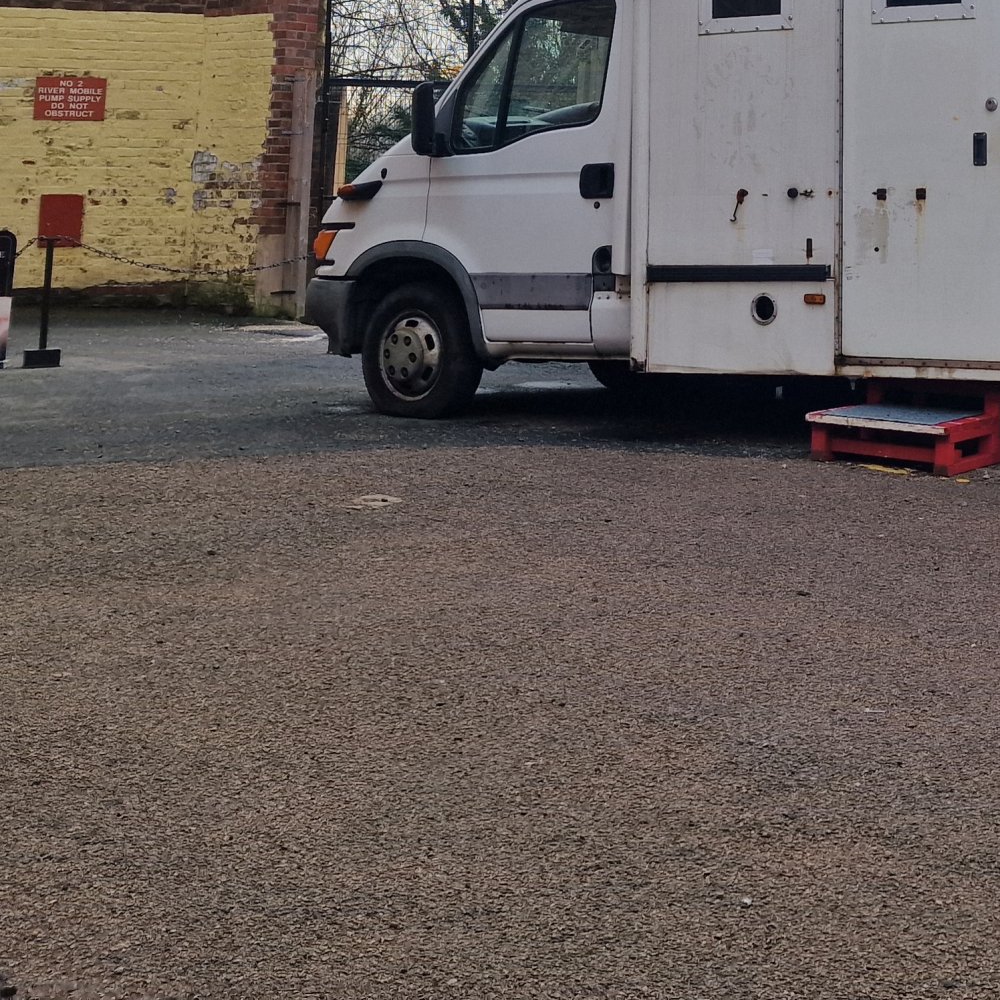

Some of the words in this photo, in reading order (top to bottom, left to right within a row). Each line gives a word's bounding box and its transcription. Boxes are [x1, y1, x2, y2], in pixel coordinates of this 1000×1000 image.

[69, 87, 103, 95] MOBILE
[39, 94, 65, 102] PUMP
[67, 95, 102, 103] SUPPLY
[69, 102, 89, 110] NOT
[44, 109, 94, 118] OBSTRUCT
